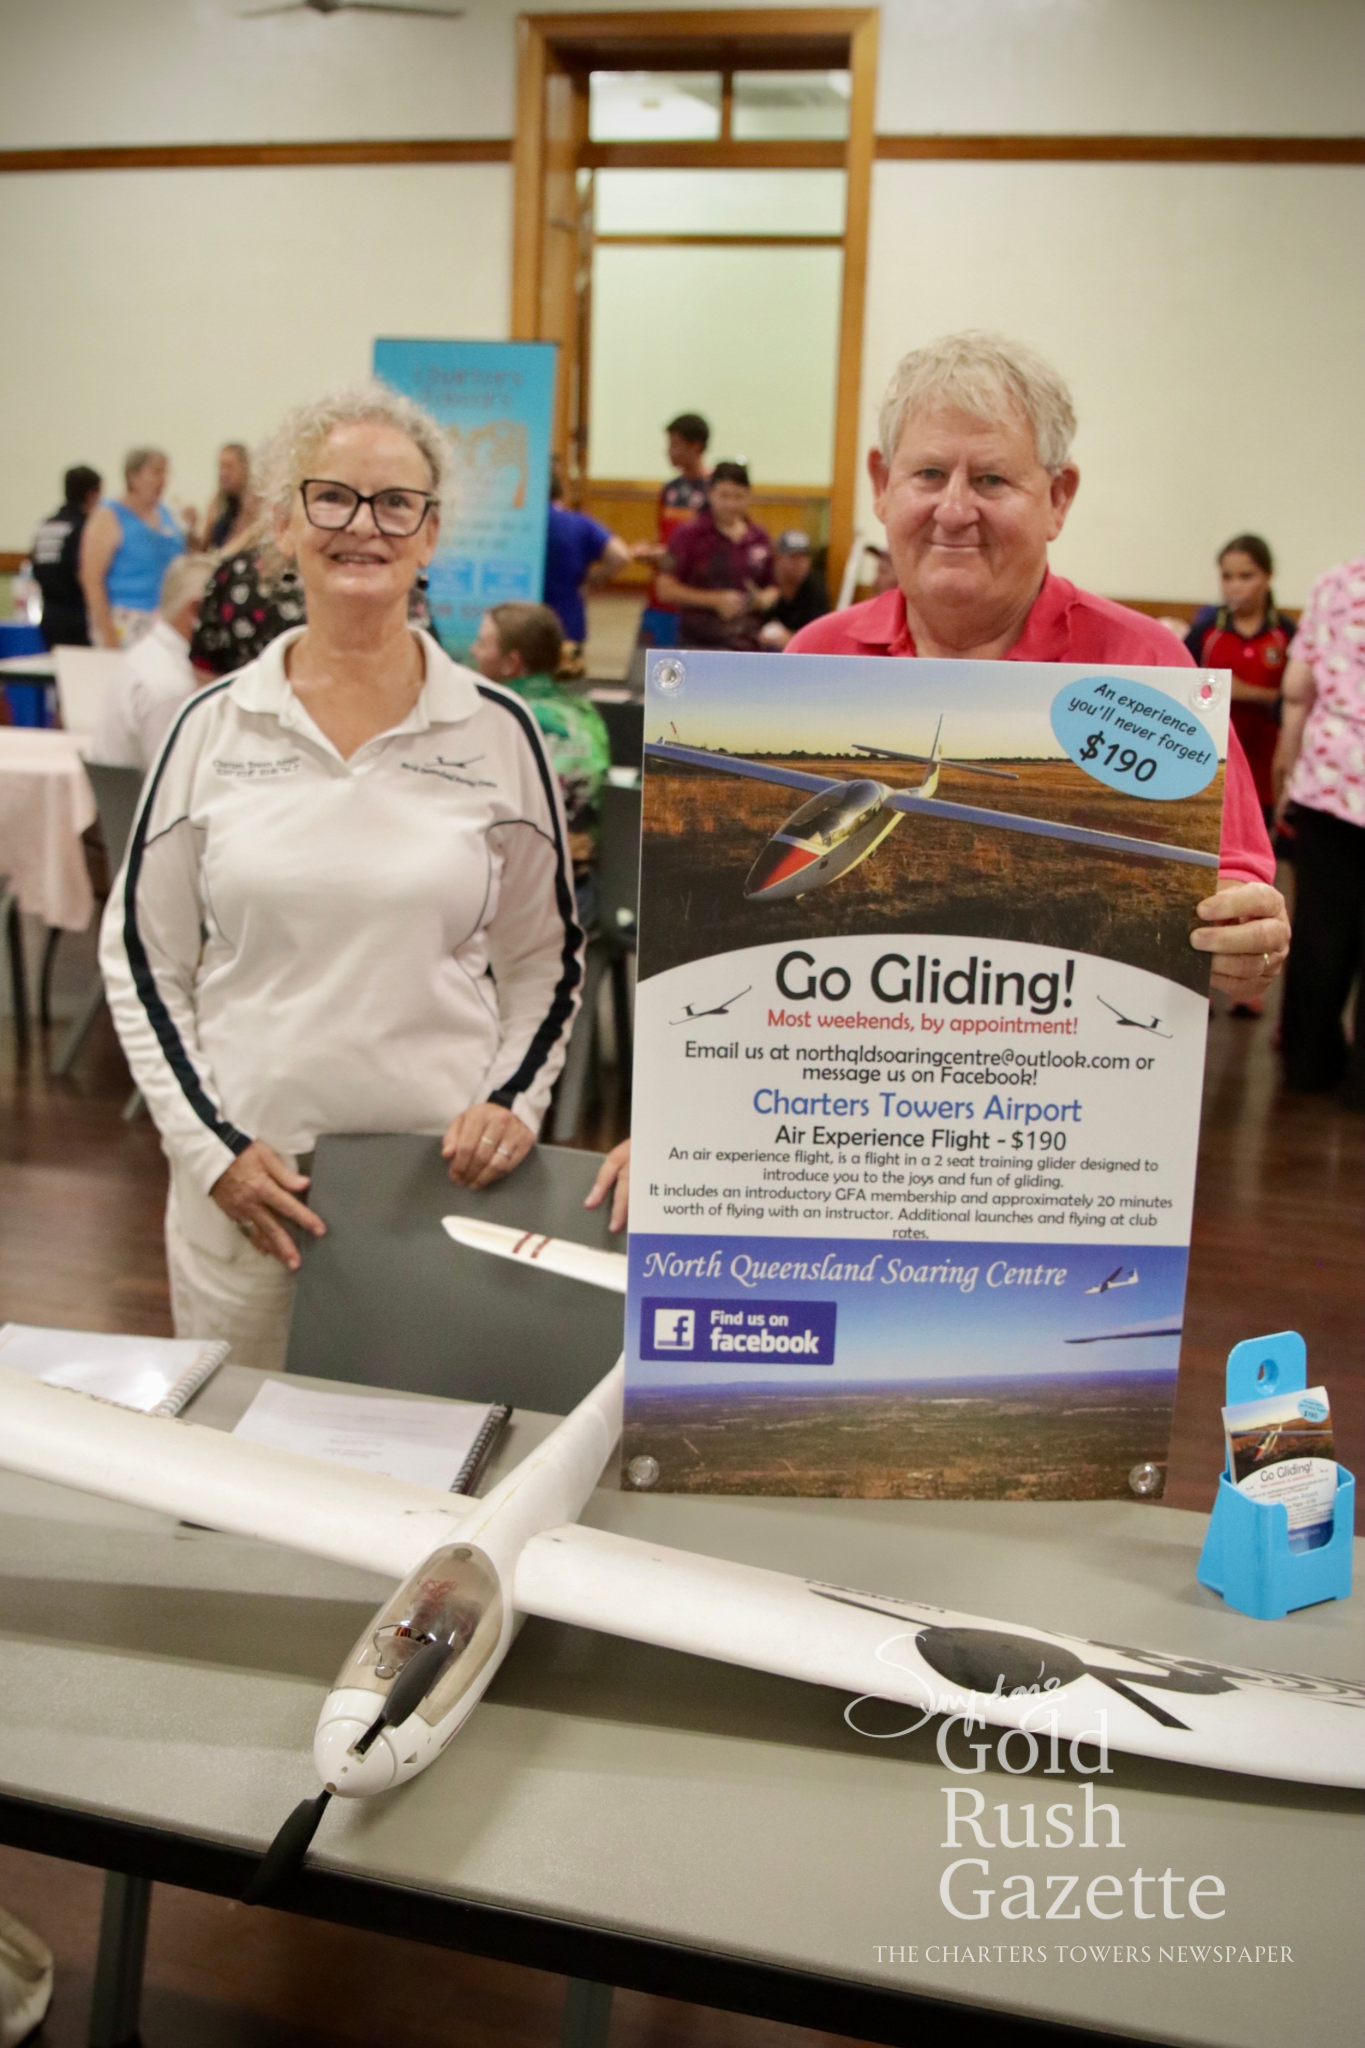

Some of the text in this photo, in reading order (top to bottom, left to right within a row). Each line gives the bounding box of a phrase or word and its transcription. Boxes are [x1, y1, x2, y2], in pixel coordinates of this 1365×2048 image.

[1093, 683, 1197, 736] An experience
[1067, 696, 1212, 765] you'll never forget!
[1079, 730, 1158, 782] $190
[775, 950, 1075, 1015] Go Gliding!
[767, 1008, 1078, 1035] Most weekends, by appointment!
[685, 1040, 739, 1059] Email
[745, 1047, 764, 1060] us
[770, 1044, 790, 1061] at
[1135, 1057, 1155, 1070] or
[802, 1067, 1037, 1086] message us on Facebook!
[753, 1088, 1082, 1126] Charters Towers Airport
[774, 1125, 806, 1144] Air
[812, 1126, 924, 1149] Experience
[931, 1129, 990, 1151] Flight
[1010, 1130, 1067, 1151] $190
[668, 1147, 1159, 1172] An air experience flight, is a flight in a 2 seat training glider designed to
[763, 1168, 1064, 1190] introduce you to the joys and fun of gliding.
[649, 1183, 1173, 1209] It includes an introductory GFA membership and approximately 20 minutes
[663, 1202, 1158, 1227] worth of flying with an instructor. Additional launches and flying at club
[892, 1226, 929, 1239] rates.
[643, 1250, 1068, 1293] North Queensland Soaring Centre
[710, 1310, 789, 1327] Find us on
[710, 1326, 820, 1354] facebook
[1260, 1470, 1275, 1482] Go
[1276, 1460, 1313, 1479] Gliding!
